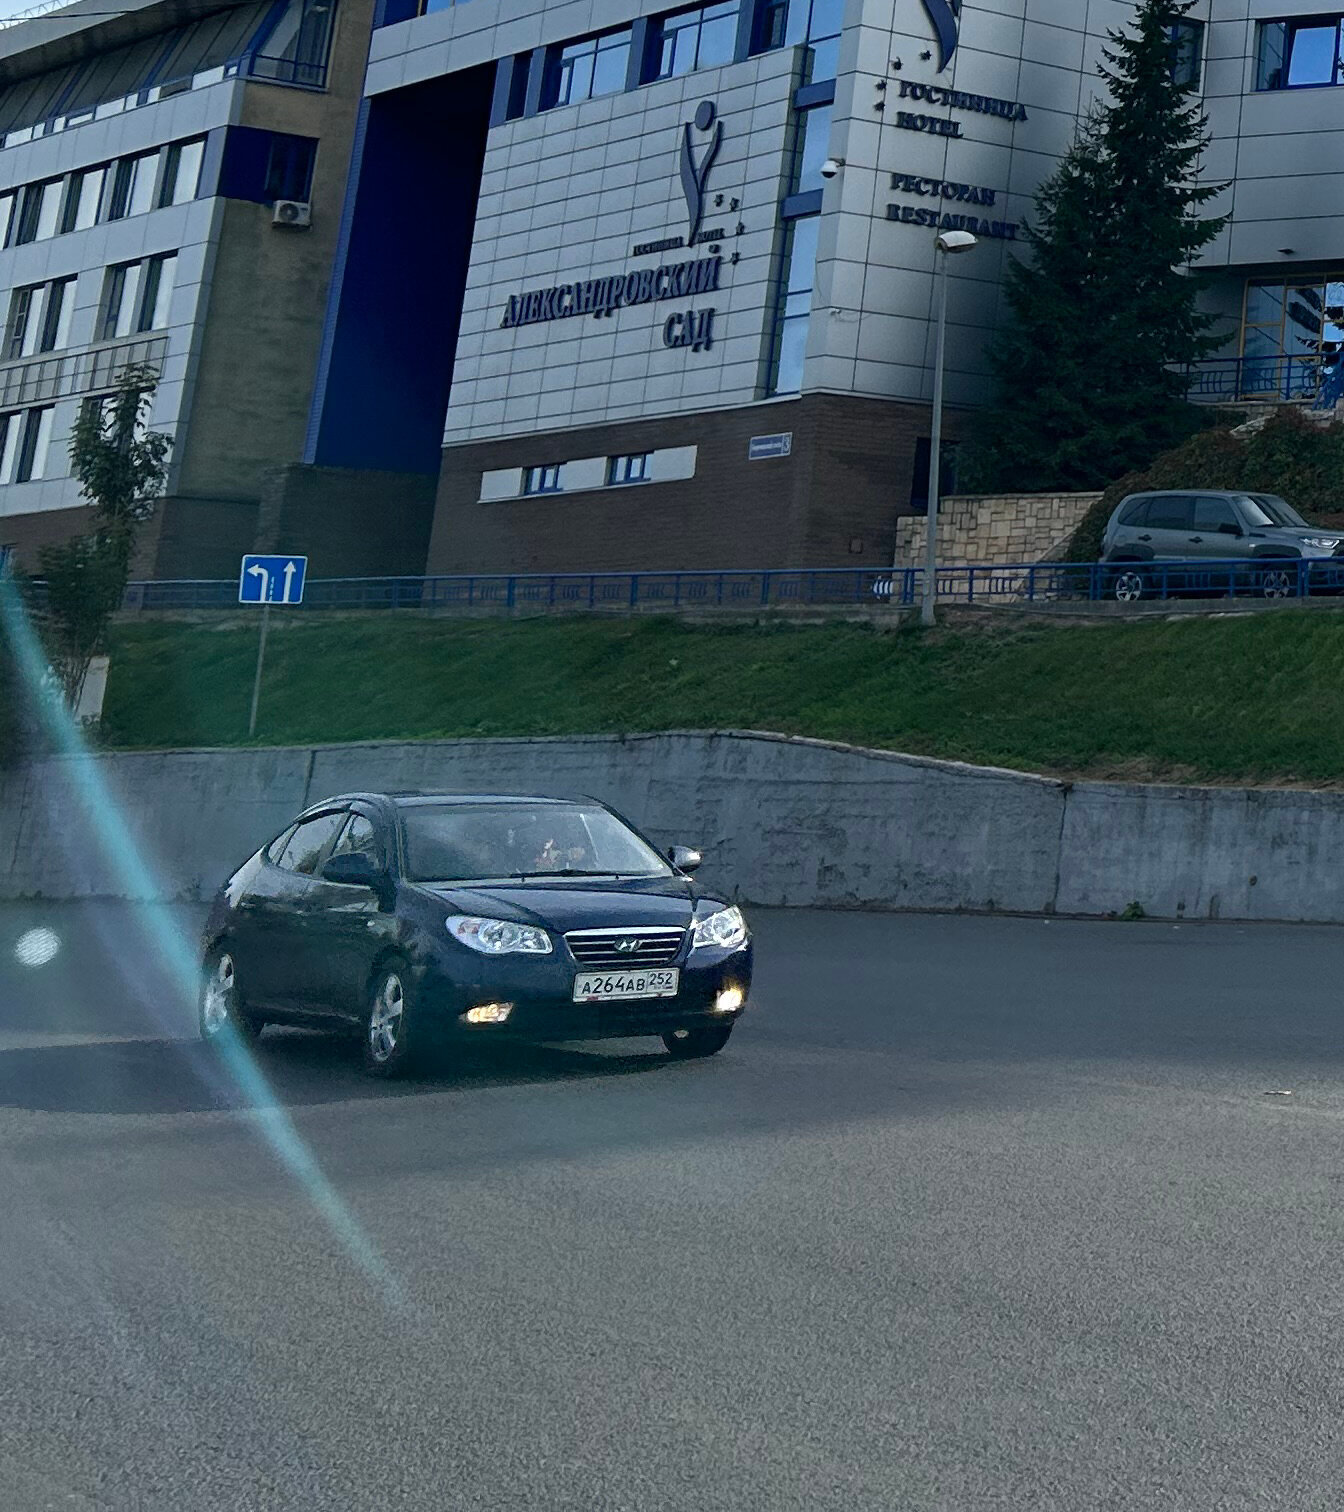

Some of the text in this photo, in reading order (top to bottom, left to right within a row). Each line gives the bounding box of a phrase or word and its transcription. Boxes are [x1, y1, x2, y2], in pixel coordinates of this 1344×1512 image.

[899, 80, 1028, 122] ГОСТИНИЦА
[896, 111, 964, 139] HOTEL
[890, 172, 996, 206] РЕСТОРАН
[886, 203, 1020, 239] RESTAURANT
[500, 243, 723, 329] АЛЕКСАНДРОВСКИЙ
[663, 307, 716, 353] САД
[581, 972, 673, 995] А264АВ 252
